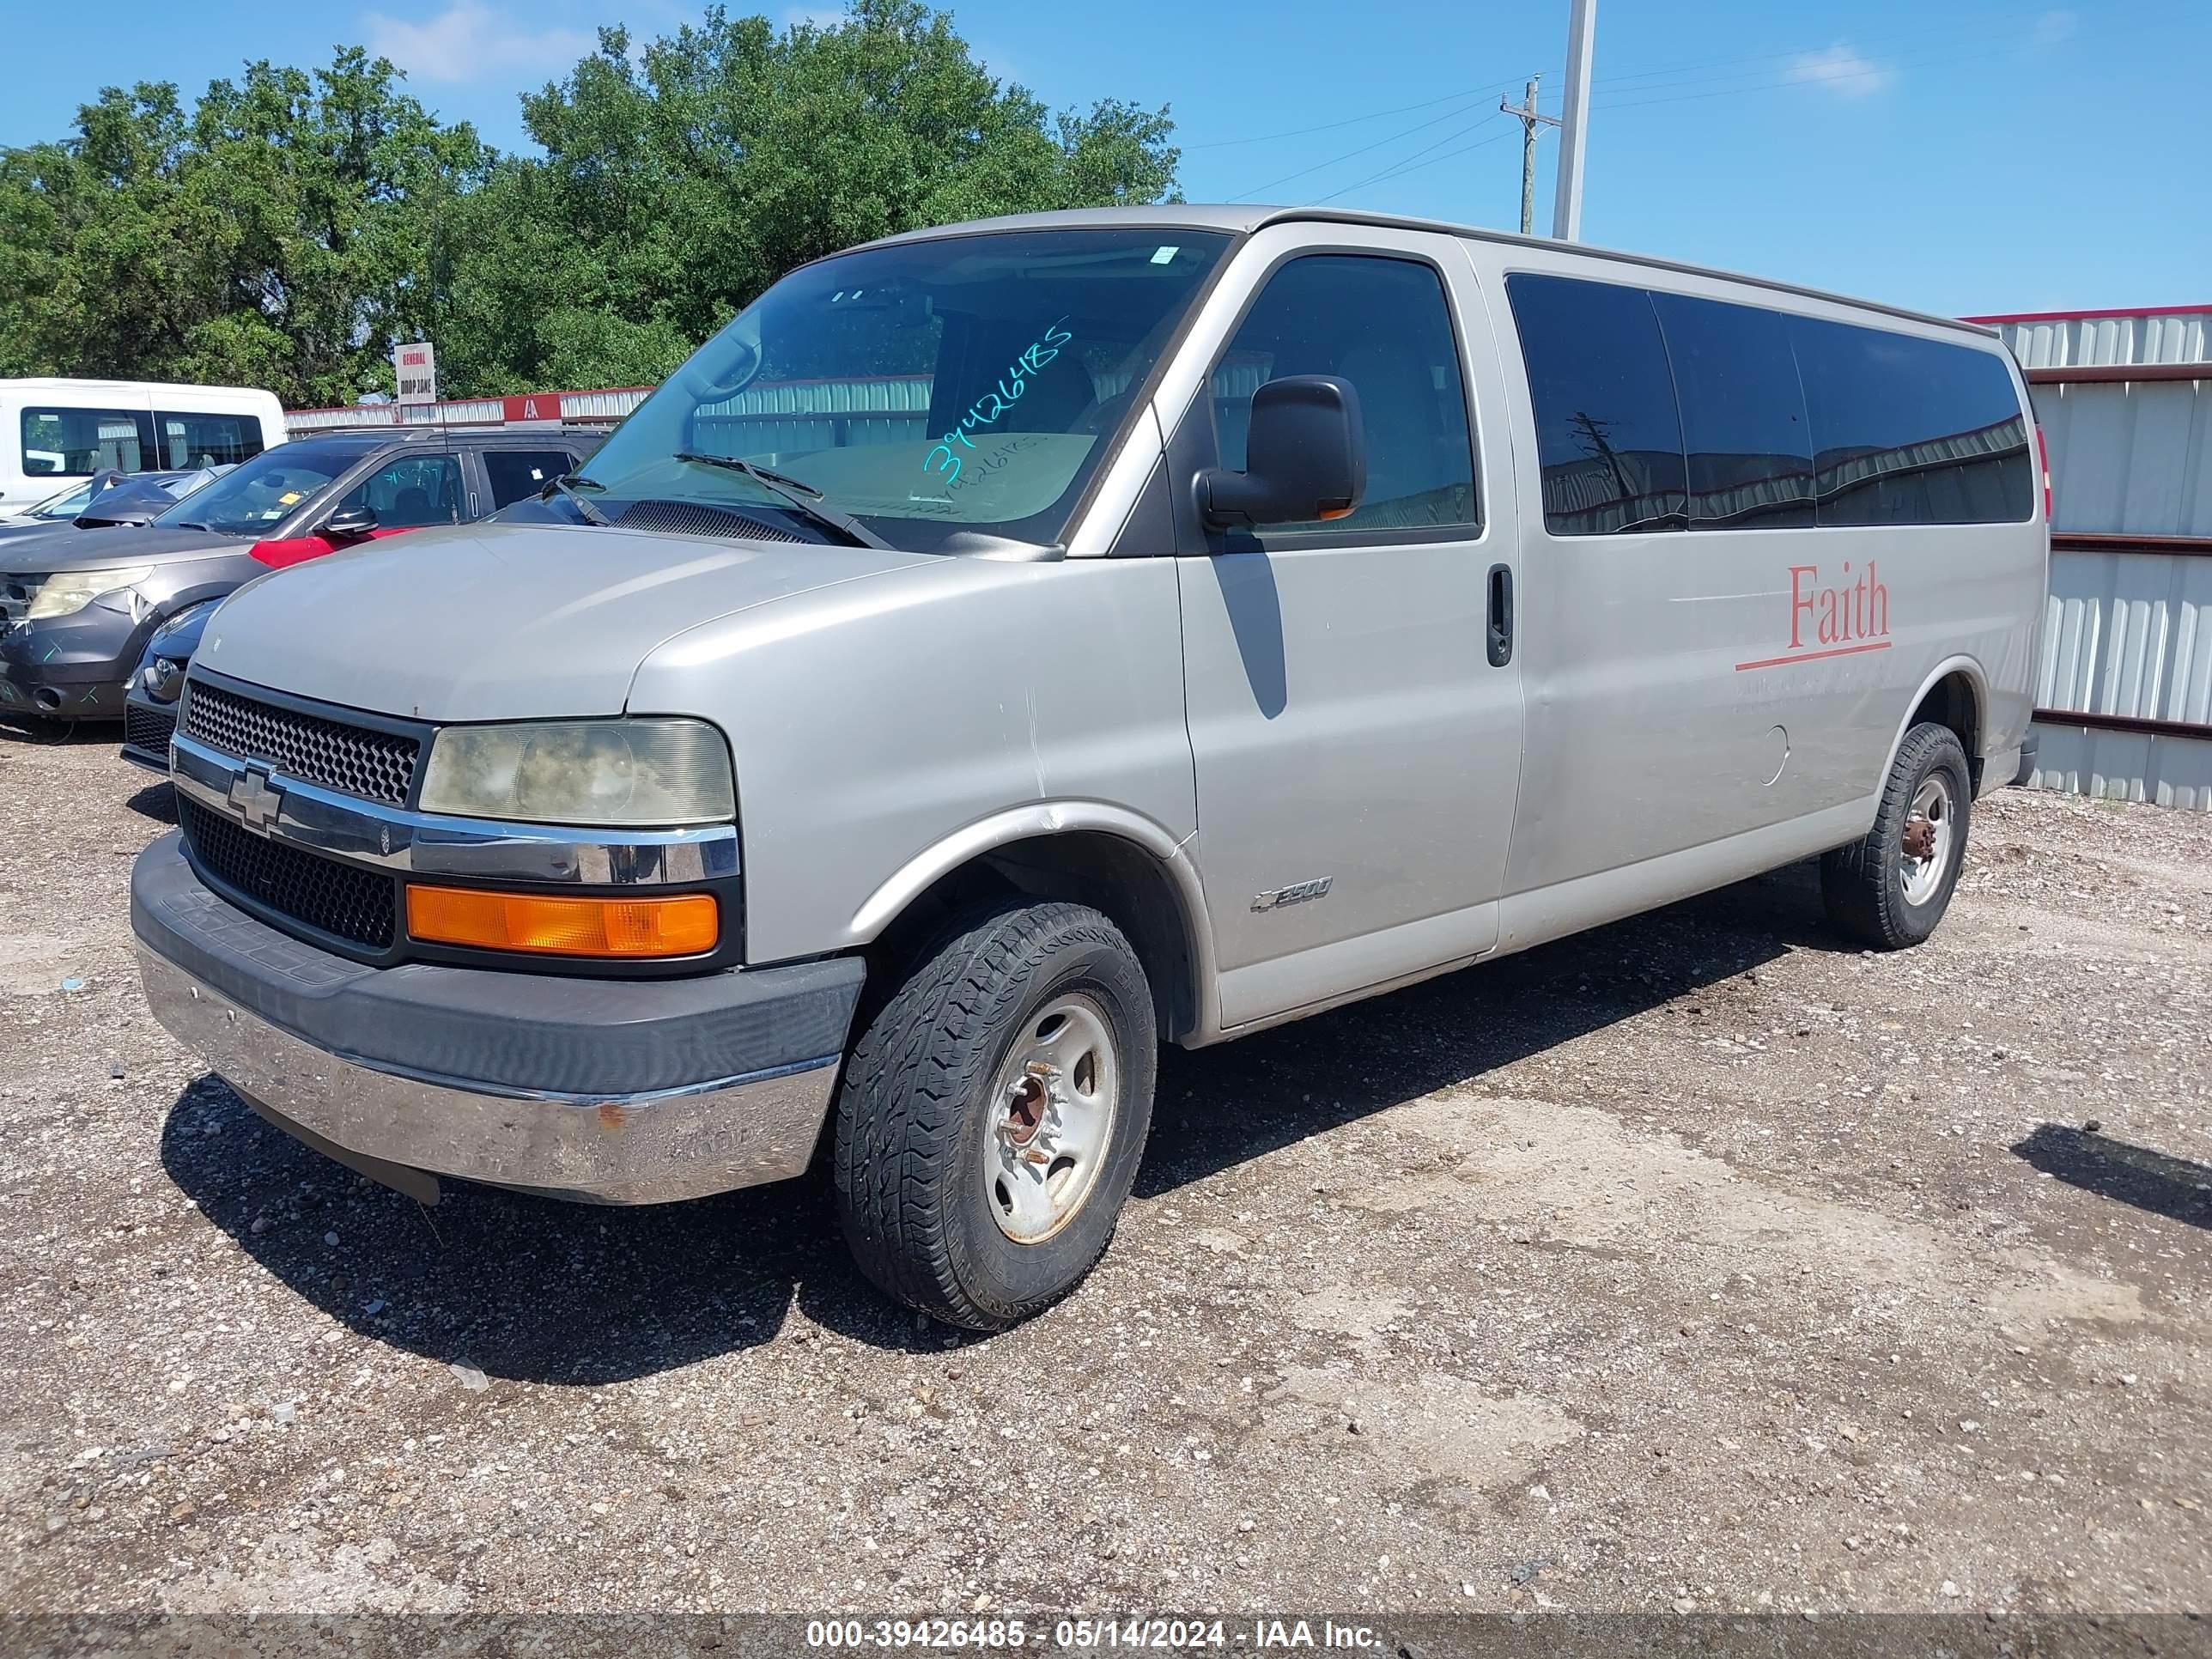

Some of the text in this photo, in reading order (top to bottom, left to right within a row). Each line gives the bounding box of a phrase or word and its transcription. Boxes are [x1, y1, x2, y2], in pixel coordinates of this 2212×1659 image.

[402, 352, 426, 366] GENERAL
[401, 378, 432, 395] DROP ZONE
[1787, 557, 1890, 649] Faith
[1275, 876, 1334, 908] 3500
